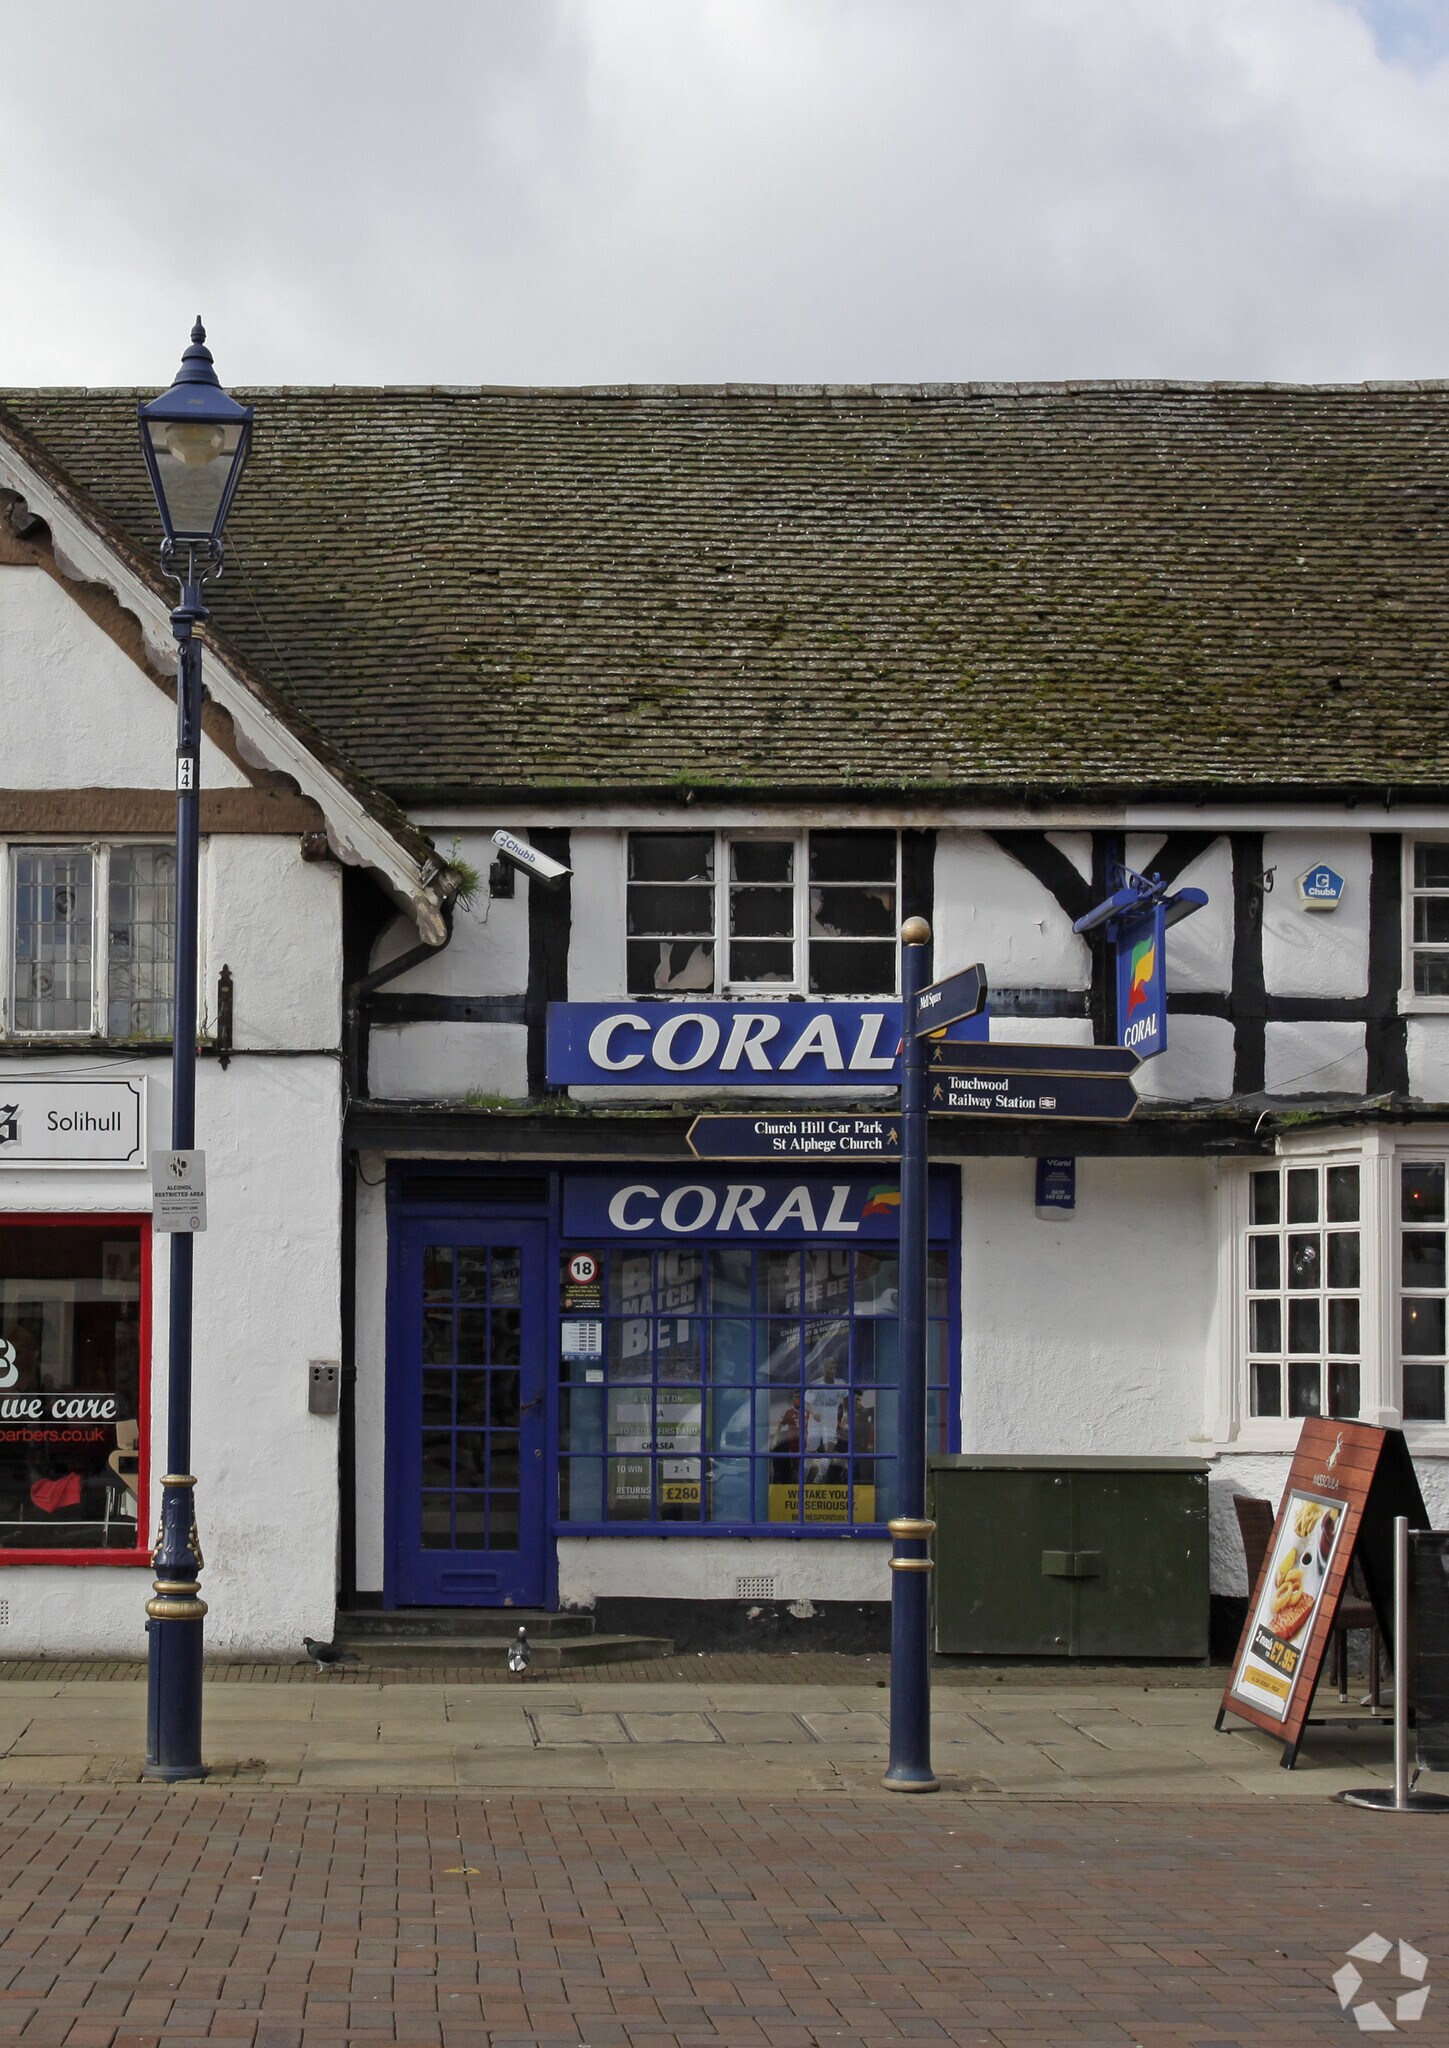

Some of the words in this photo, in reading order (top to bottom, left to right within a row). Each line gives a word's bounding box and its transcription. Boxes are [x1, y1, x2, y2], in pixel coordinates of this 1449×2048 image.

[506, 840, 536, 863] Chubb
[1308, 887, 1336, 896] Chubb
[1124, 1013, 1157, 1047] CORAL
[588, 1013, 895, 1071] CORAL
[948, 1076, 1009, 1091] Touchwood
[948, 1093, 992, 1109] Railway
[995, 1094, 1036, 1109] Station
[47, 1110, 121, 1132] Solihull
[754, 1121, 797, 1134] Church
[801, 1121, 825, 1134] Hill
[828, 1121, 850, 1134] Car
[854, 1121, 883, 1134] Park
[773, 1138, 786, 1150] St
[790, 1138, 837, 1152] Alphege
[840, 1137, 883, 1150] Church
[608, 1184, 860, 1232] CORAL
[573, 1261, 592, 1275] 18
[623, 1283, 695, 1315] MATCH
[623, 1304, 695, 1359] BET
[672, 1395, 683, 1403] ON
[0, 1398, 43, 1419] we
[52, 1398, 117, 1419] care
[620, 1427, 629, 1435] TO
[630, 1427, 652, 1435] SCOR
[658, 1427, 679, 1435] FIRST
[681, 1427, 698, 1435] AND
[641, 1442, 675, 1450] CHLSEA
[617, 1465, 625, 1473] TO
[627, 1465, 643, 1473] WIN
[1312, 1474, 1339, 1491] MISSOULA
[616, 1486, 652, 1495] RETURNS
[666, 1487, 699, 1500] £280
[804, 1490, 827, 1499] TAKE
[829, 1490, 855, 1500] YOU
